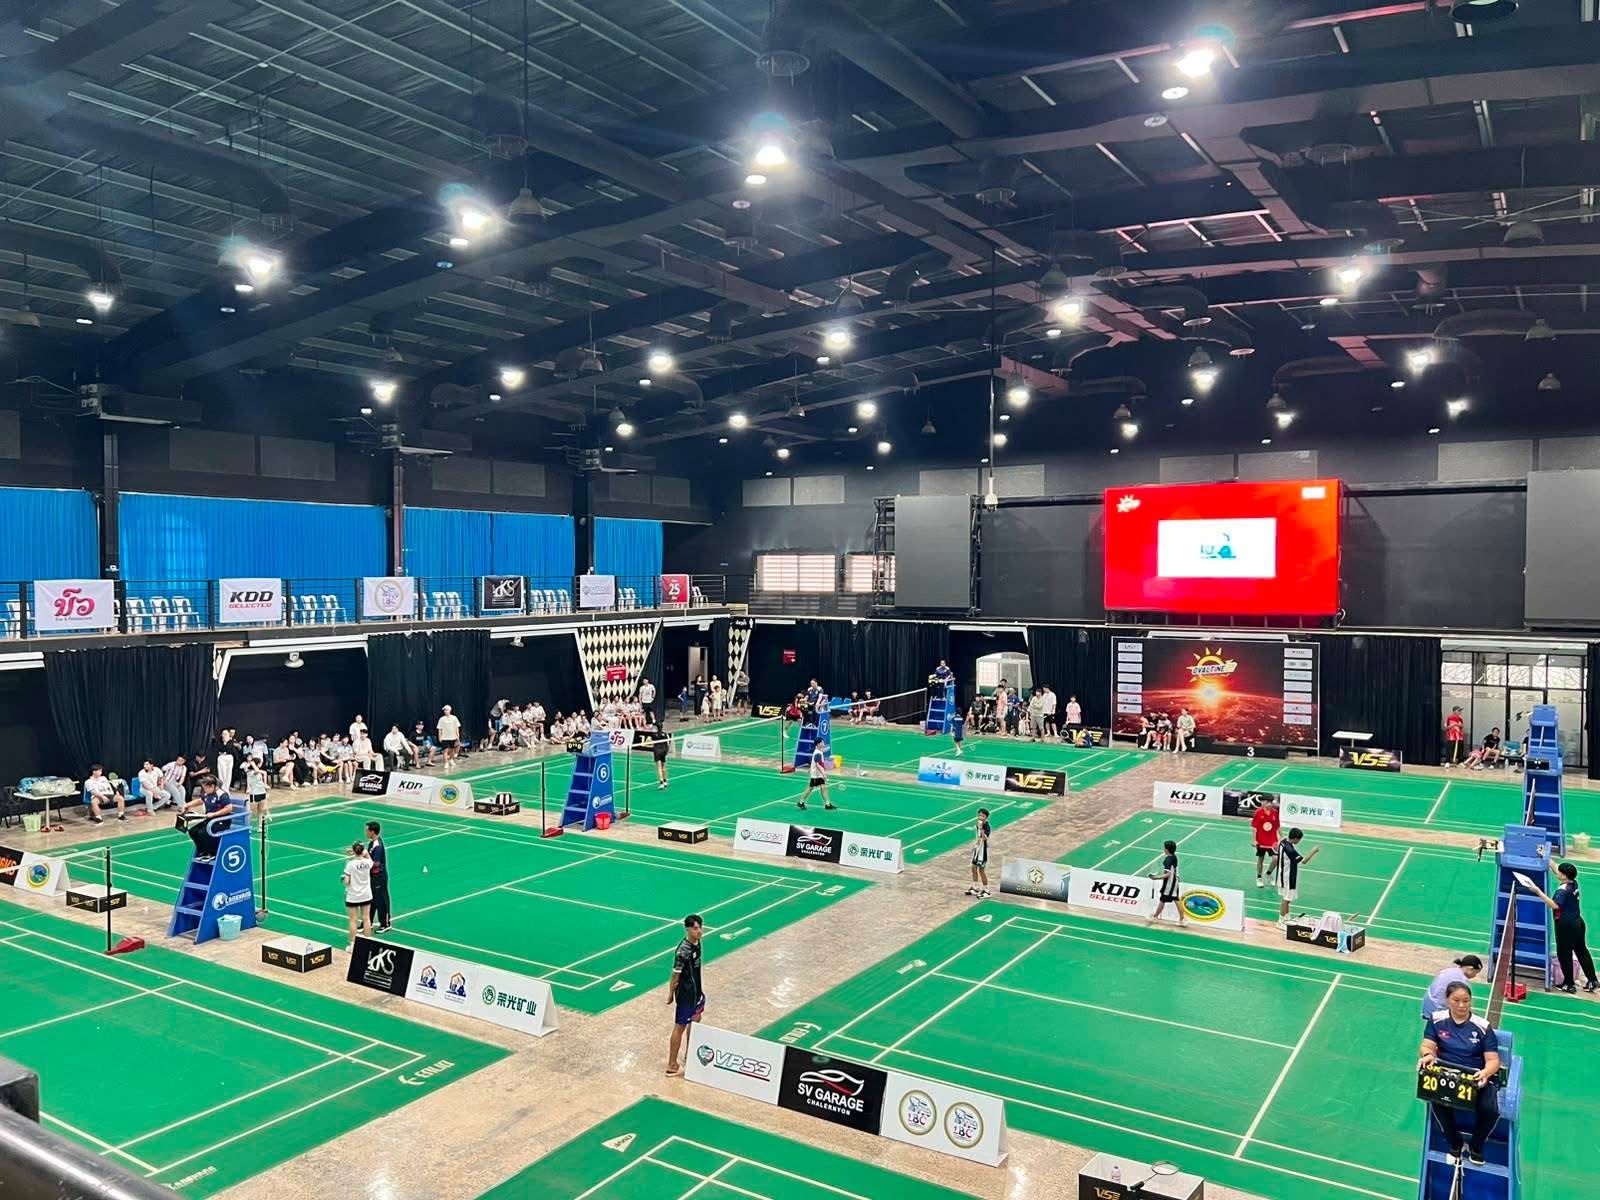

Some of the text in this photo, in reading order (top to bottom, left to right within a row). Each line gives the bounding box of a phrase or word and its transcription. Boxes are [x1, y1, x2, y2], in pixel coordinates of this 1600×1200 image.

[230, 591, 273, 602] KDD
[1247, 746, 1255, 757] 3
[600, 767, 607, 779] 6
[1170, 790, 1207, 801] KDD
[796, 841, 832, 854] SV GARAGE
[228, 851, 240, 867] 5
[1091, 881, 1140, 899] KDD
[1090, 893, 1138, 905] SELECTED
[497, 992, 537, 1016] 荣光矿业
[716, 1049, 771, 1077] VPS3
[1423, 1075, 1438, 1091] 20
[1440, 1078, 1447, 1087] 0
[1448, 1081, 1456, 1089] 0
[1457, 1084, 1472, 1101] 21
[797, 1082, 865, 1112] SV GARAGE
